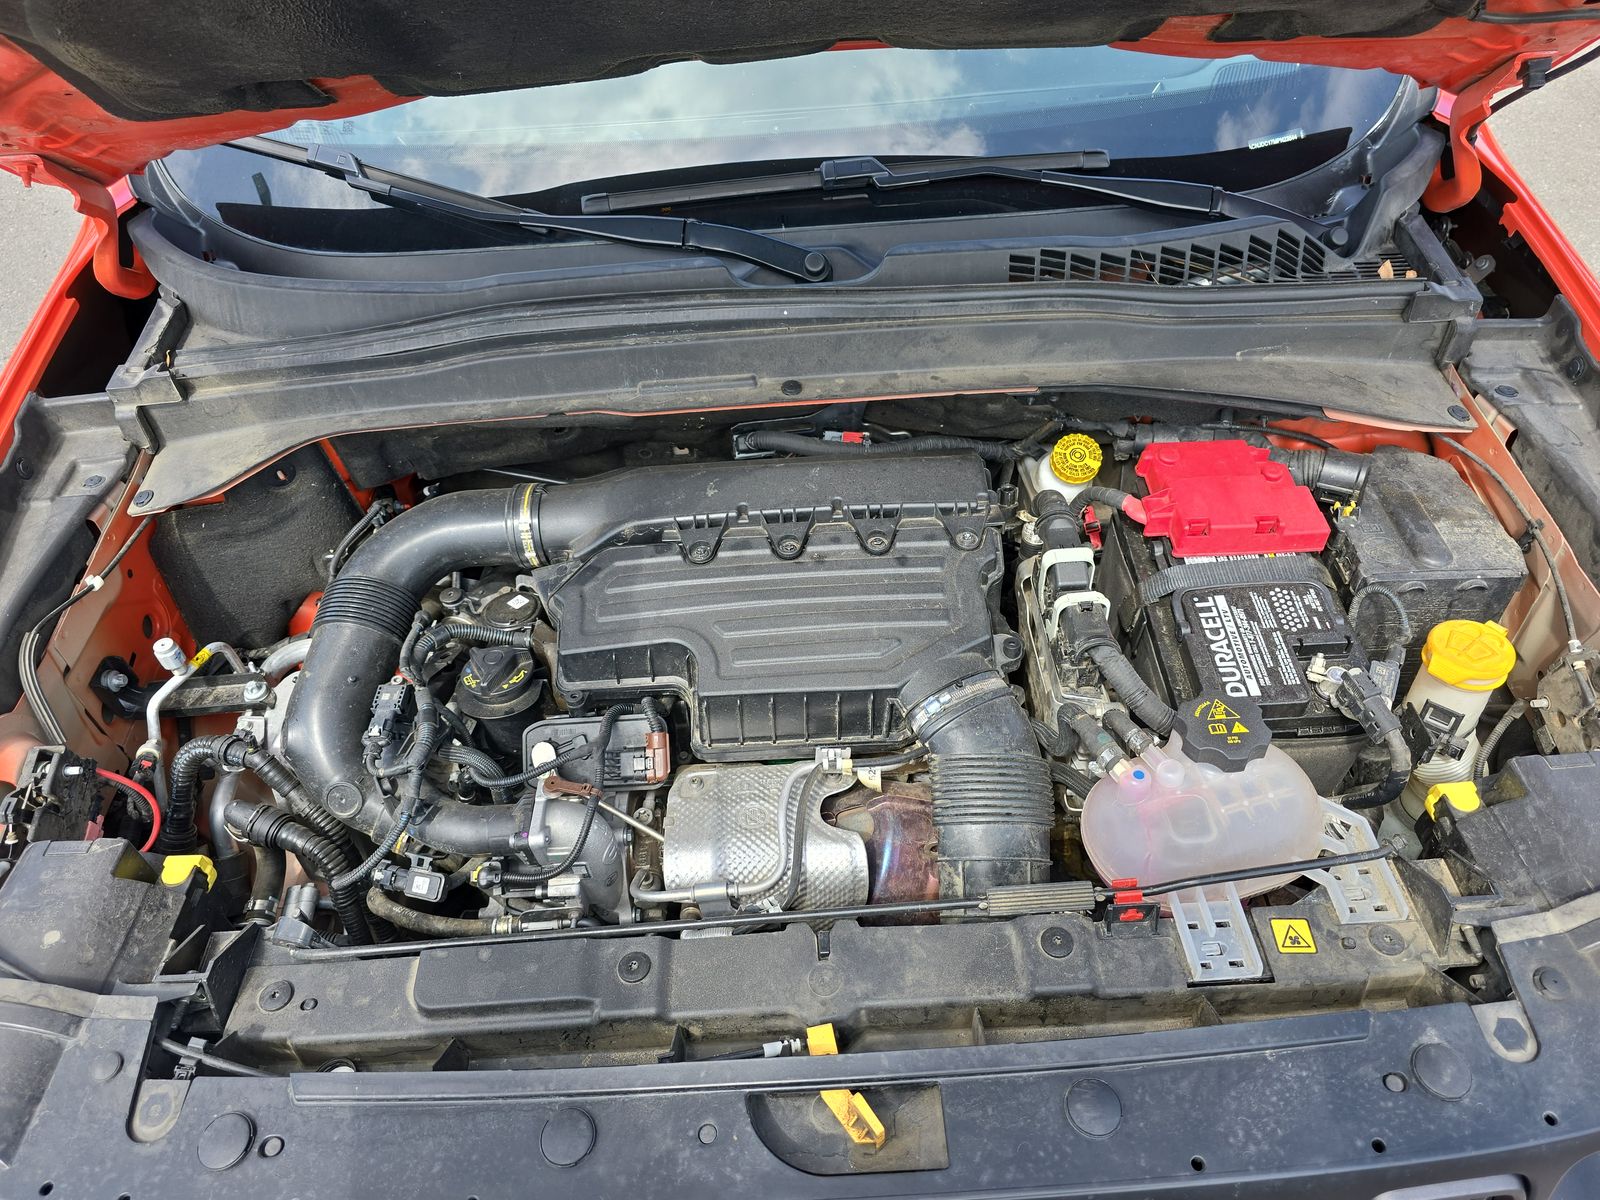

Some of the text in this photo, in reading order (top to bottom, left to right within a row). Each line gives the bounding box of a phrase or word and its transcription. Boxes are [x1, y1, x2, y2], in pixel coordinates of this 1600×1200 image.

[1221, 609, 1232, 623] LTV
[1195, 597, 1248, 697] DURACELL
[1229, 630, 1254, 680] AUTOMOTIVE
